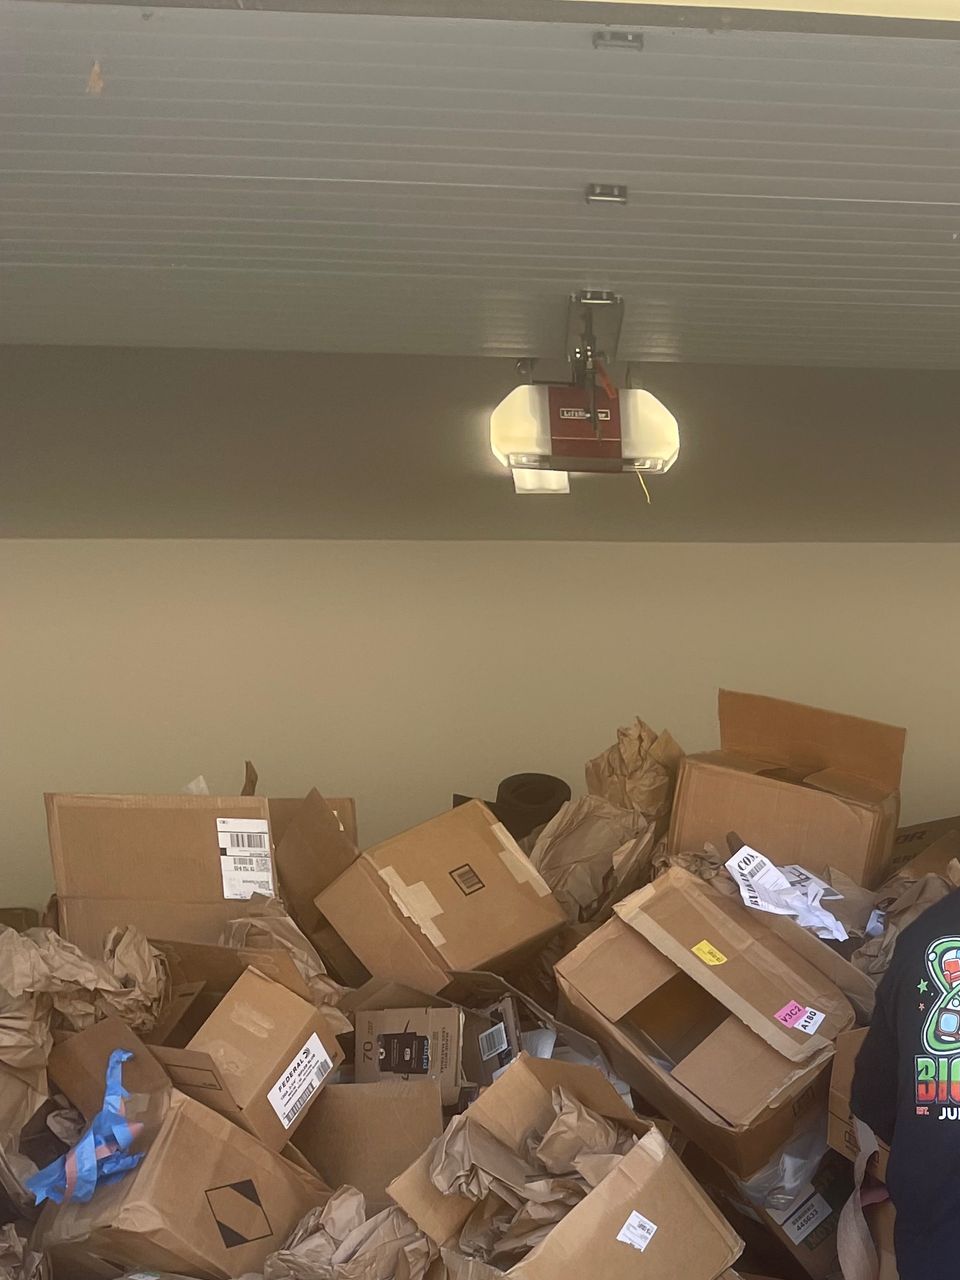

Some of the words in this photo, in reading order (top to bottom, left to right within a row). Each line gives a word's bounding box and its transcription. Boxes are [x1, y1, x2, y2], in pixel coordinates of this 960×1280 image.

[780, 1005, 802, 1023] V3C2
[801, 1010, 817, 1030] A180
[362, 1041, 374, 1063] 70
[422, 1039, 430, 1069] prime
[278, 1059, 304, 1093] FEDERAL
